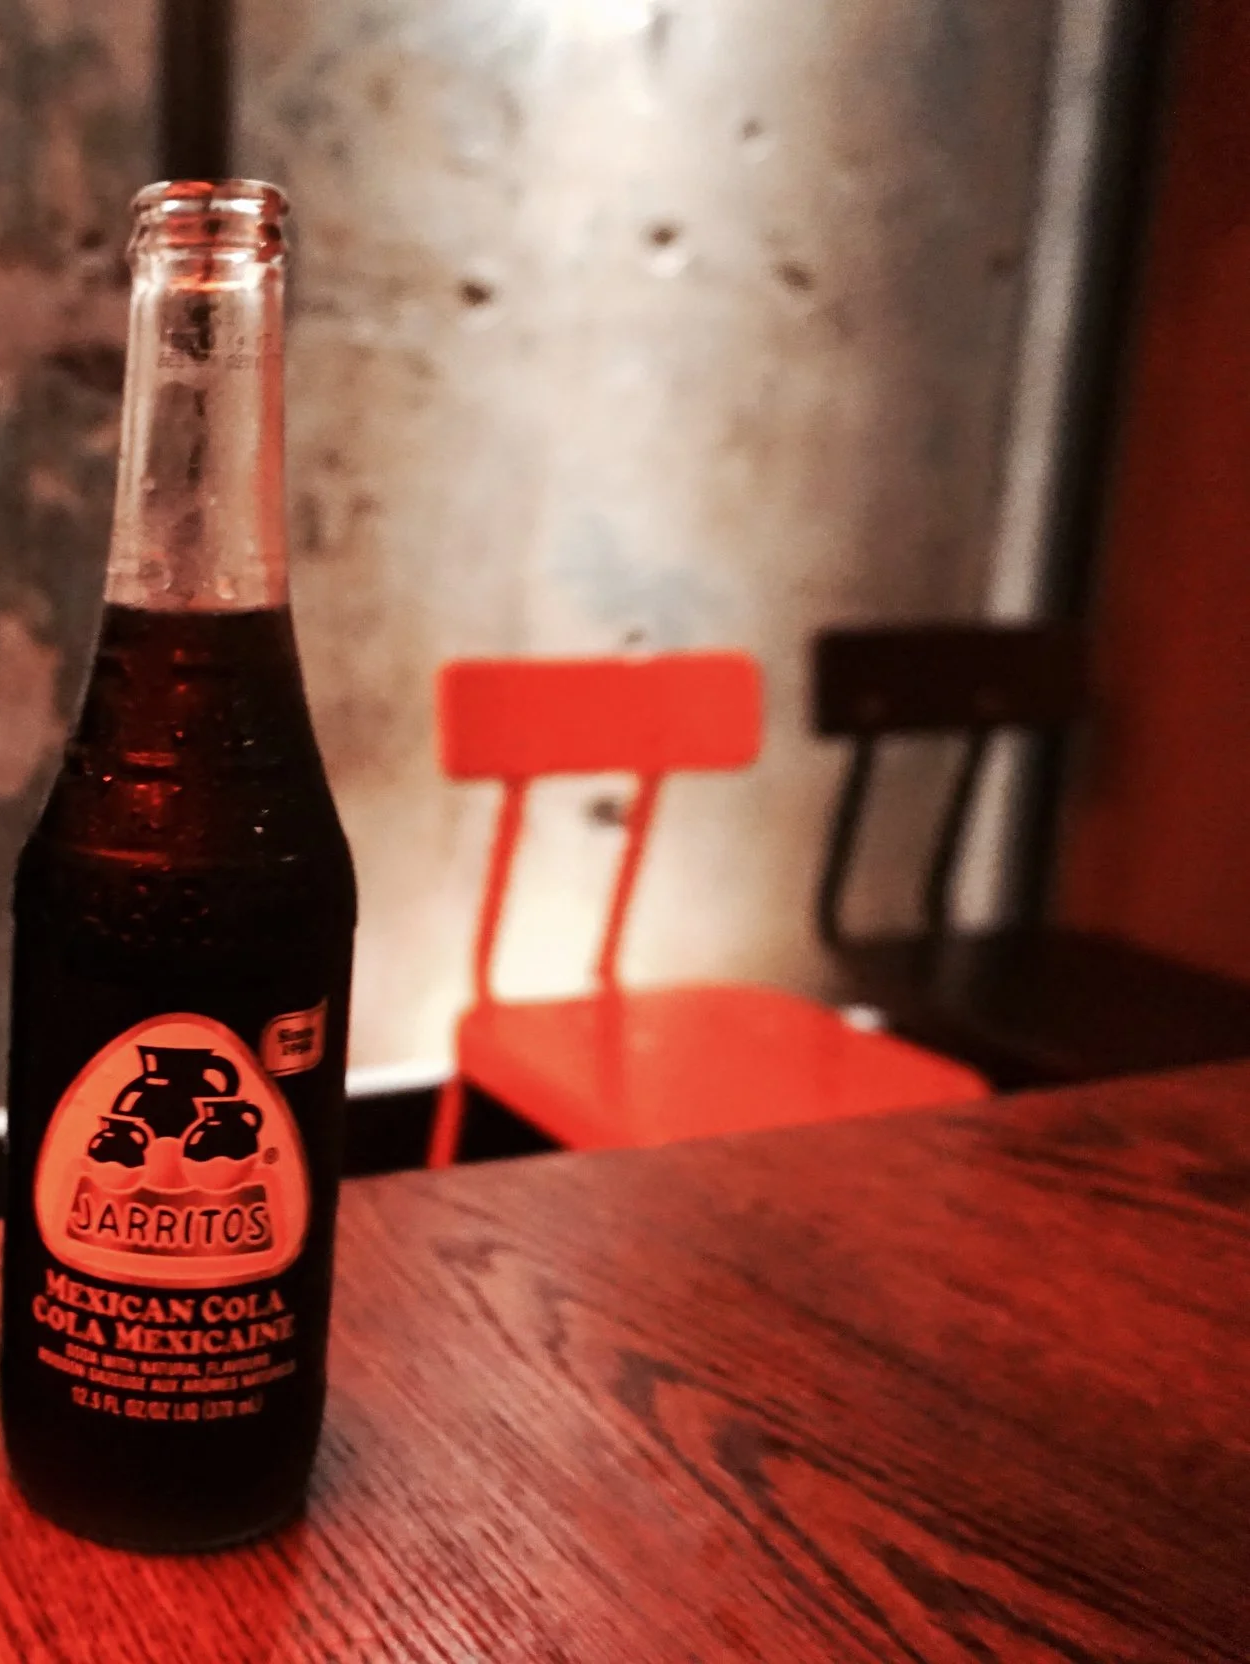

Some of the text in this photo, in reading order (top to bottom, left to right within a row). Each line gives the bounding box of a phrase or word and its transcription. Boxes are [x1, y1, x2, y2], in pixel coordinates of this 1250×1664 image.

[74, 1194, 268, 1246] JARRITOS
[46, 1268, 285, 1323] MEXICAN COLA
[32, 1295, 295, 1354] COLA MEXICAINE
